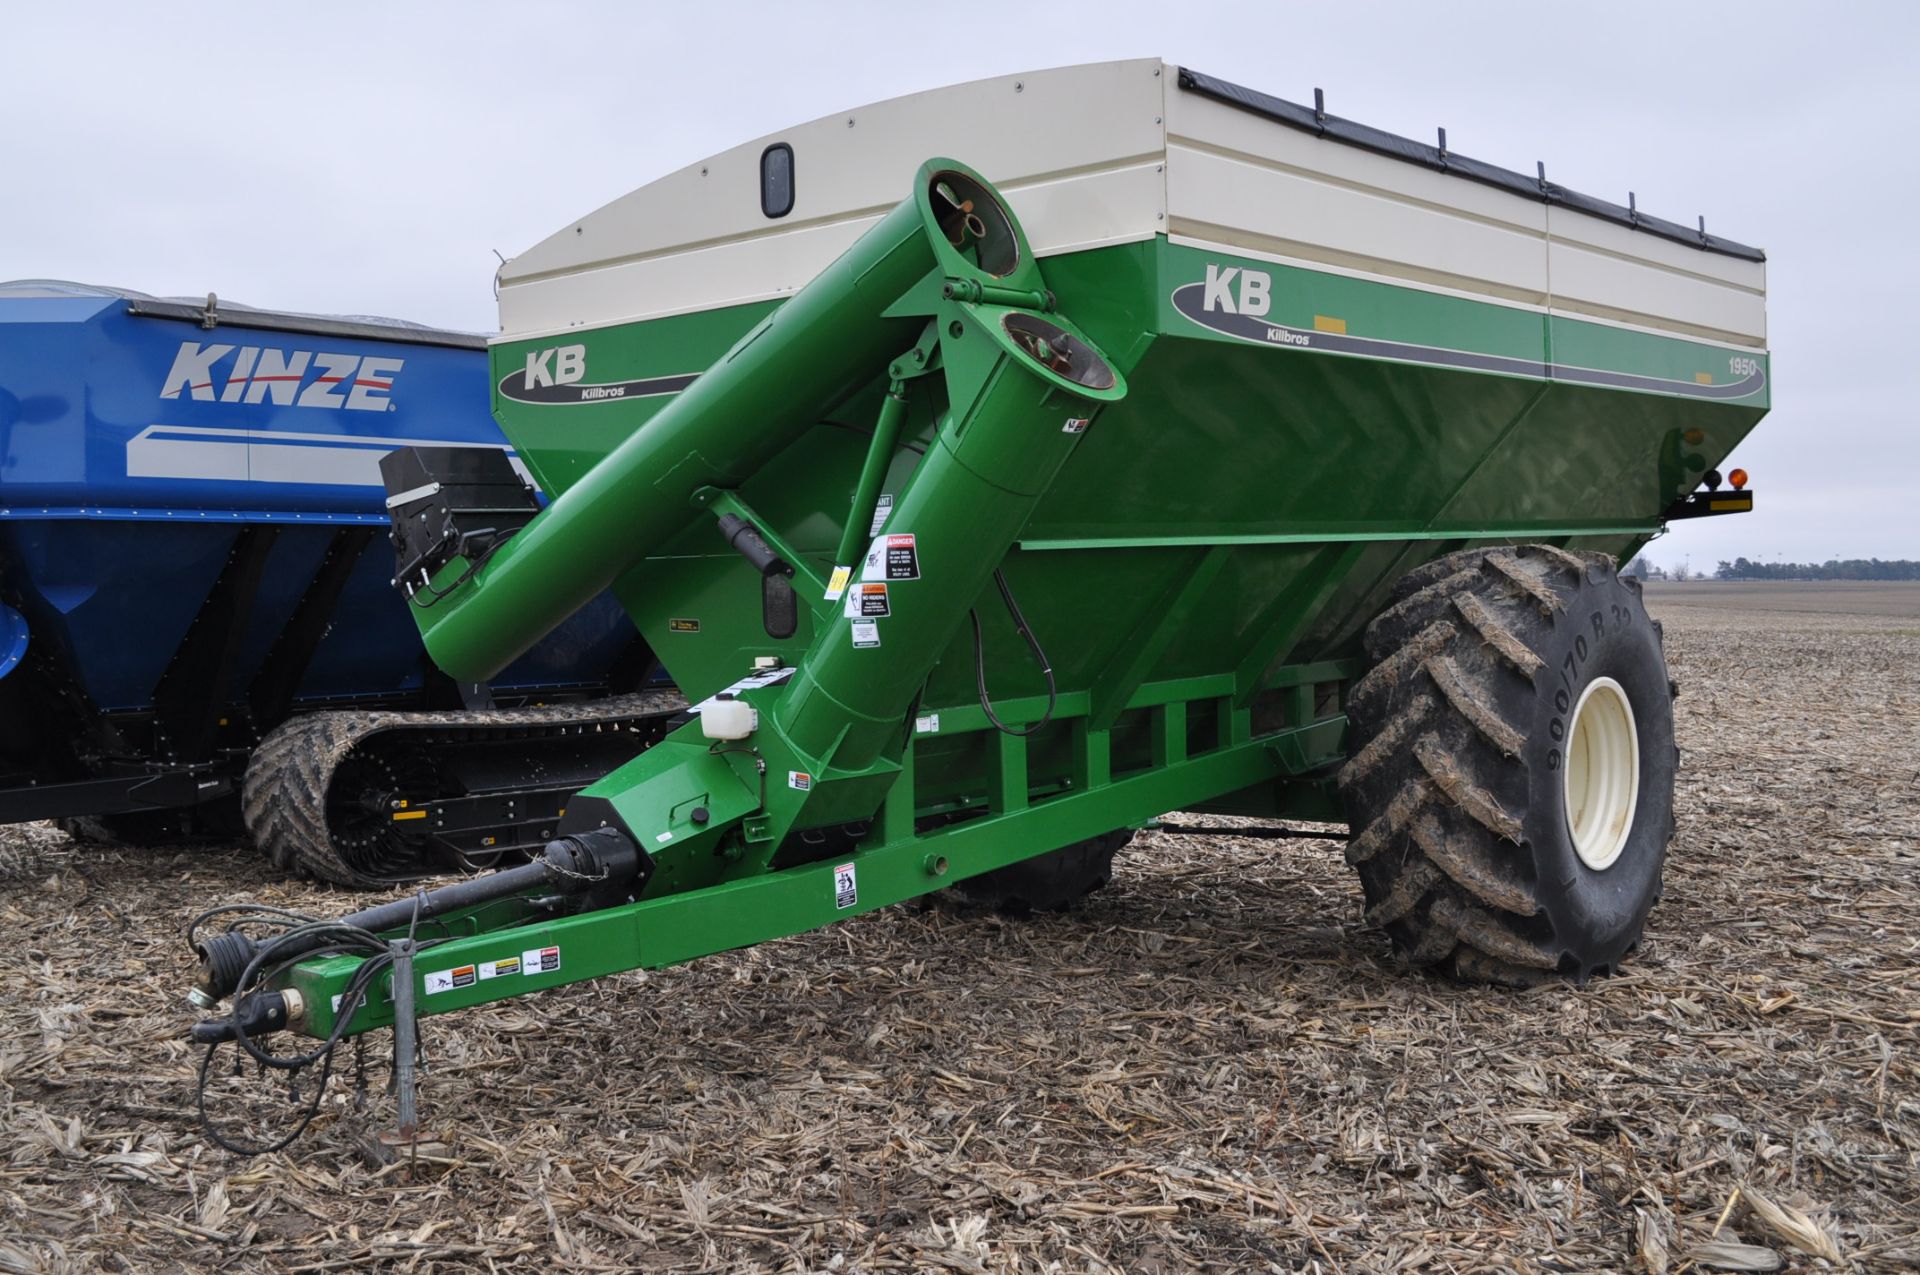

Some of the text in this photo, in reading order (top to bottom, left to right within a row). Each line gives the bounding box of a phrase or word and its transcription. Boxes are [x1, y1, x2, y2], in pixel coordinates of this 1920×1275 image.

[1203, 264, 1272, 317] KB
[1267, 328, 1310, 345] Killbros
[160, 341, 405, 412] KINZE
[524, 344, 586, 390] KB
[1729, 357, 1757, 376] 1950
[581, 387, 625, 400] Killbros
